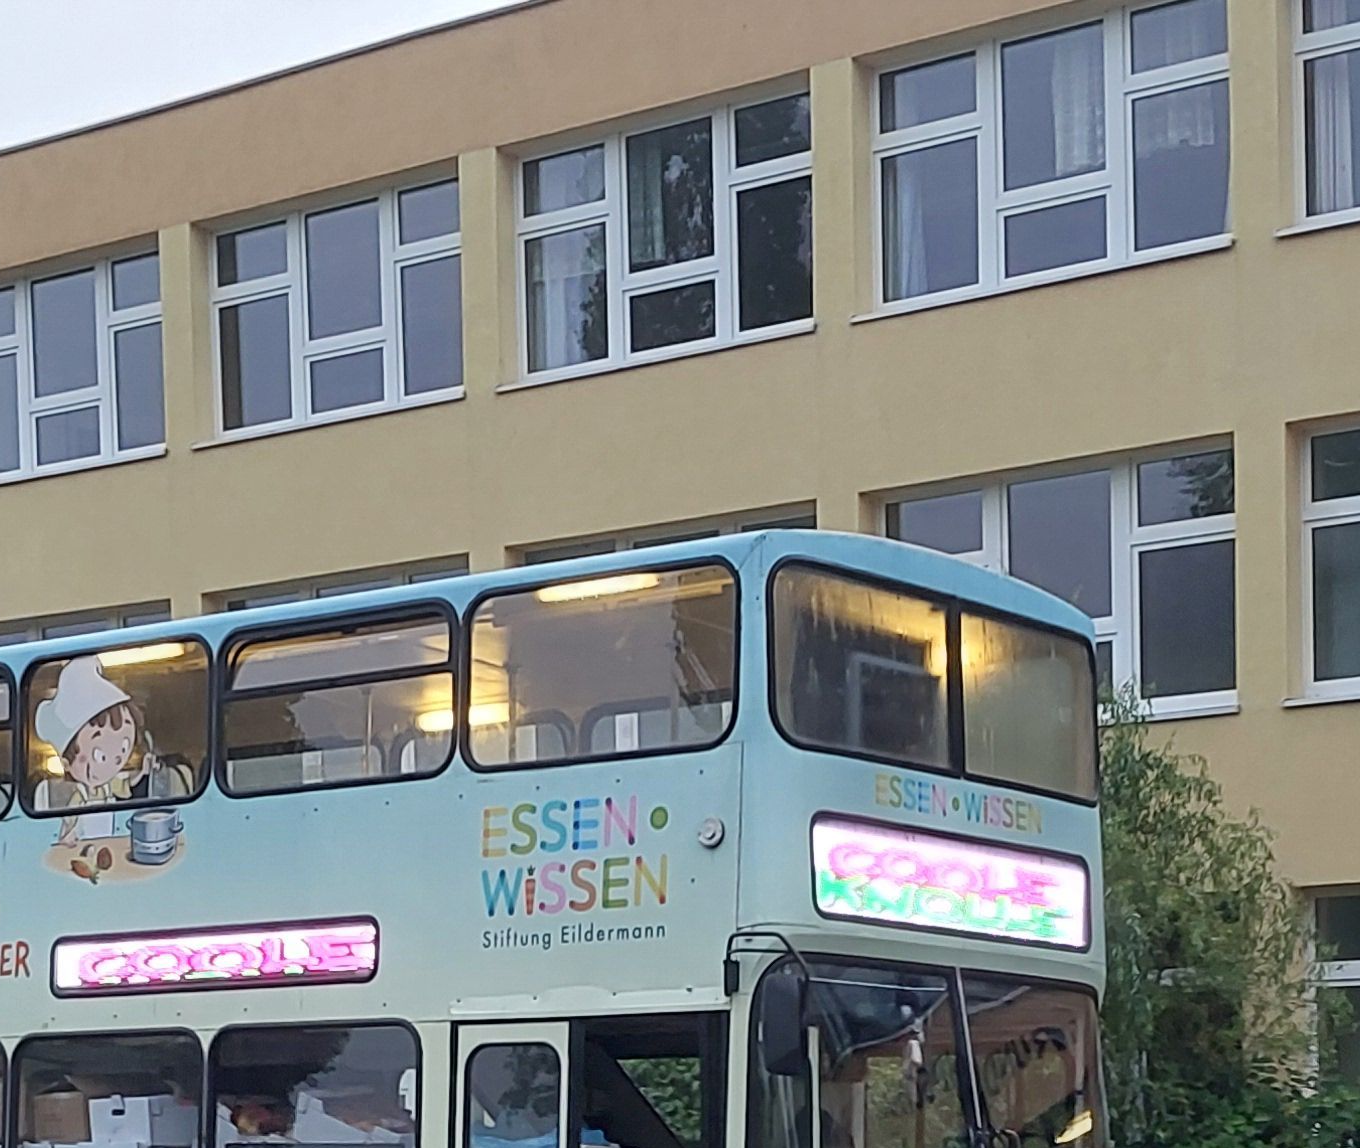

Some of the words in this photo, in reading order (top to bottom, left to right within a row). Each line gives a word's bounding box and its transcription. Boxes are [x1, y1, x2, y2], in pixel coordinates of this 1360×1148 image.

[875, 773, 947, 817] ESSEN
[482, 795, 637, 858] ESSEN
[828, 842, 1059, 907] COOLE
[78, 927, 375, 985] COOLE
[482, 927, 552, 950] Stiftung
[560, 922, 666, 944] Eildermann
